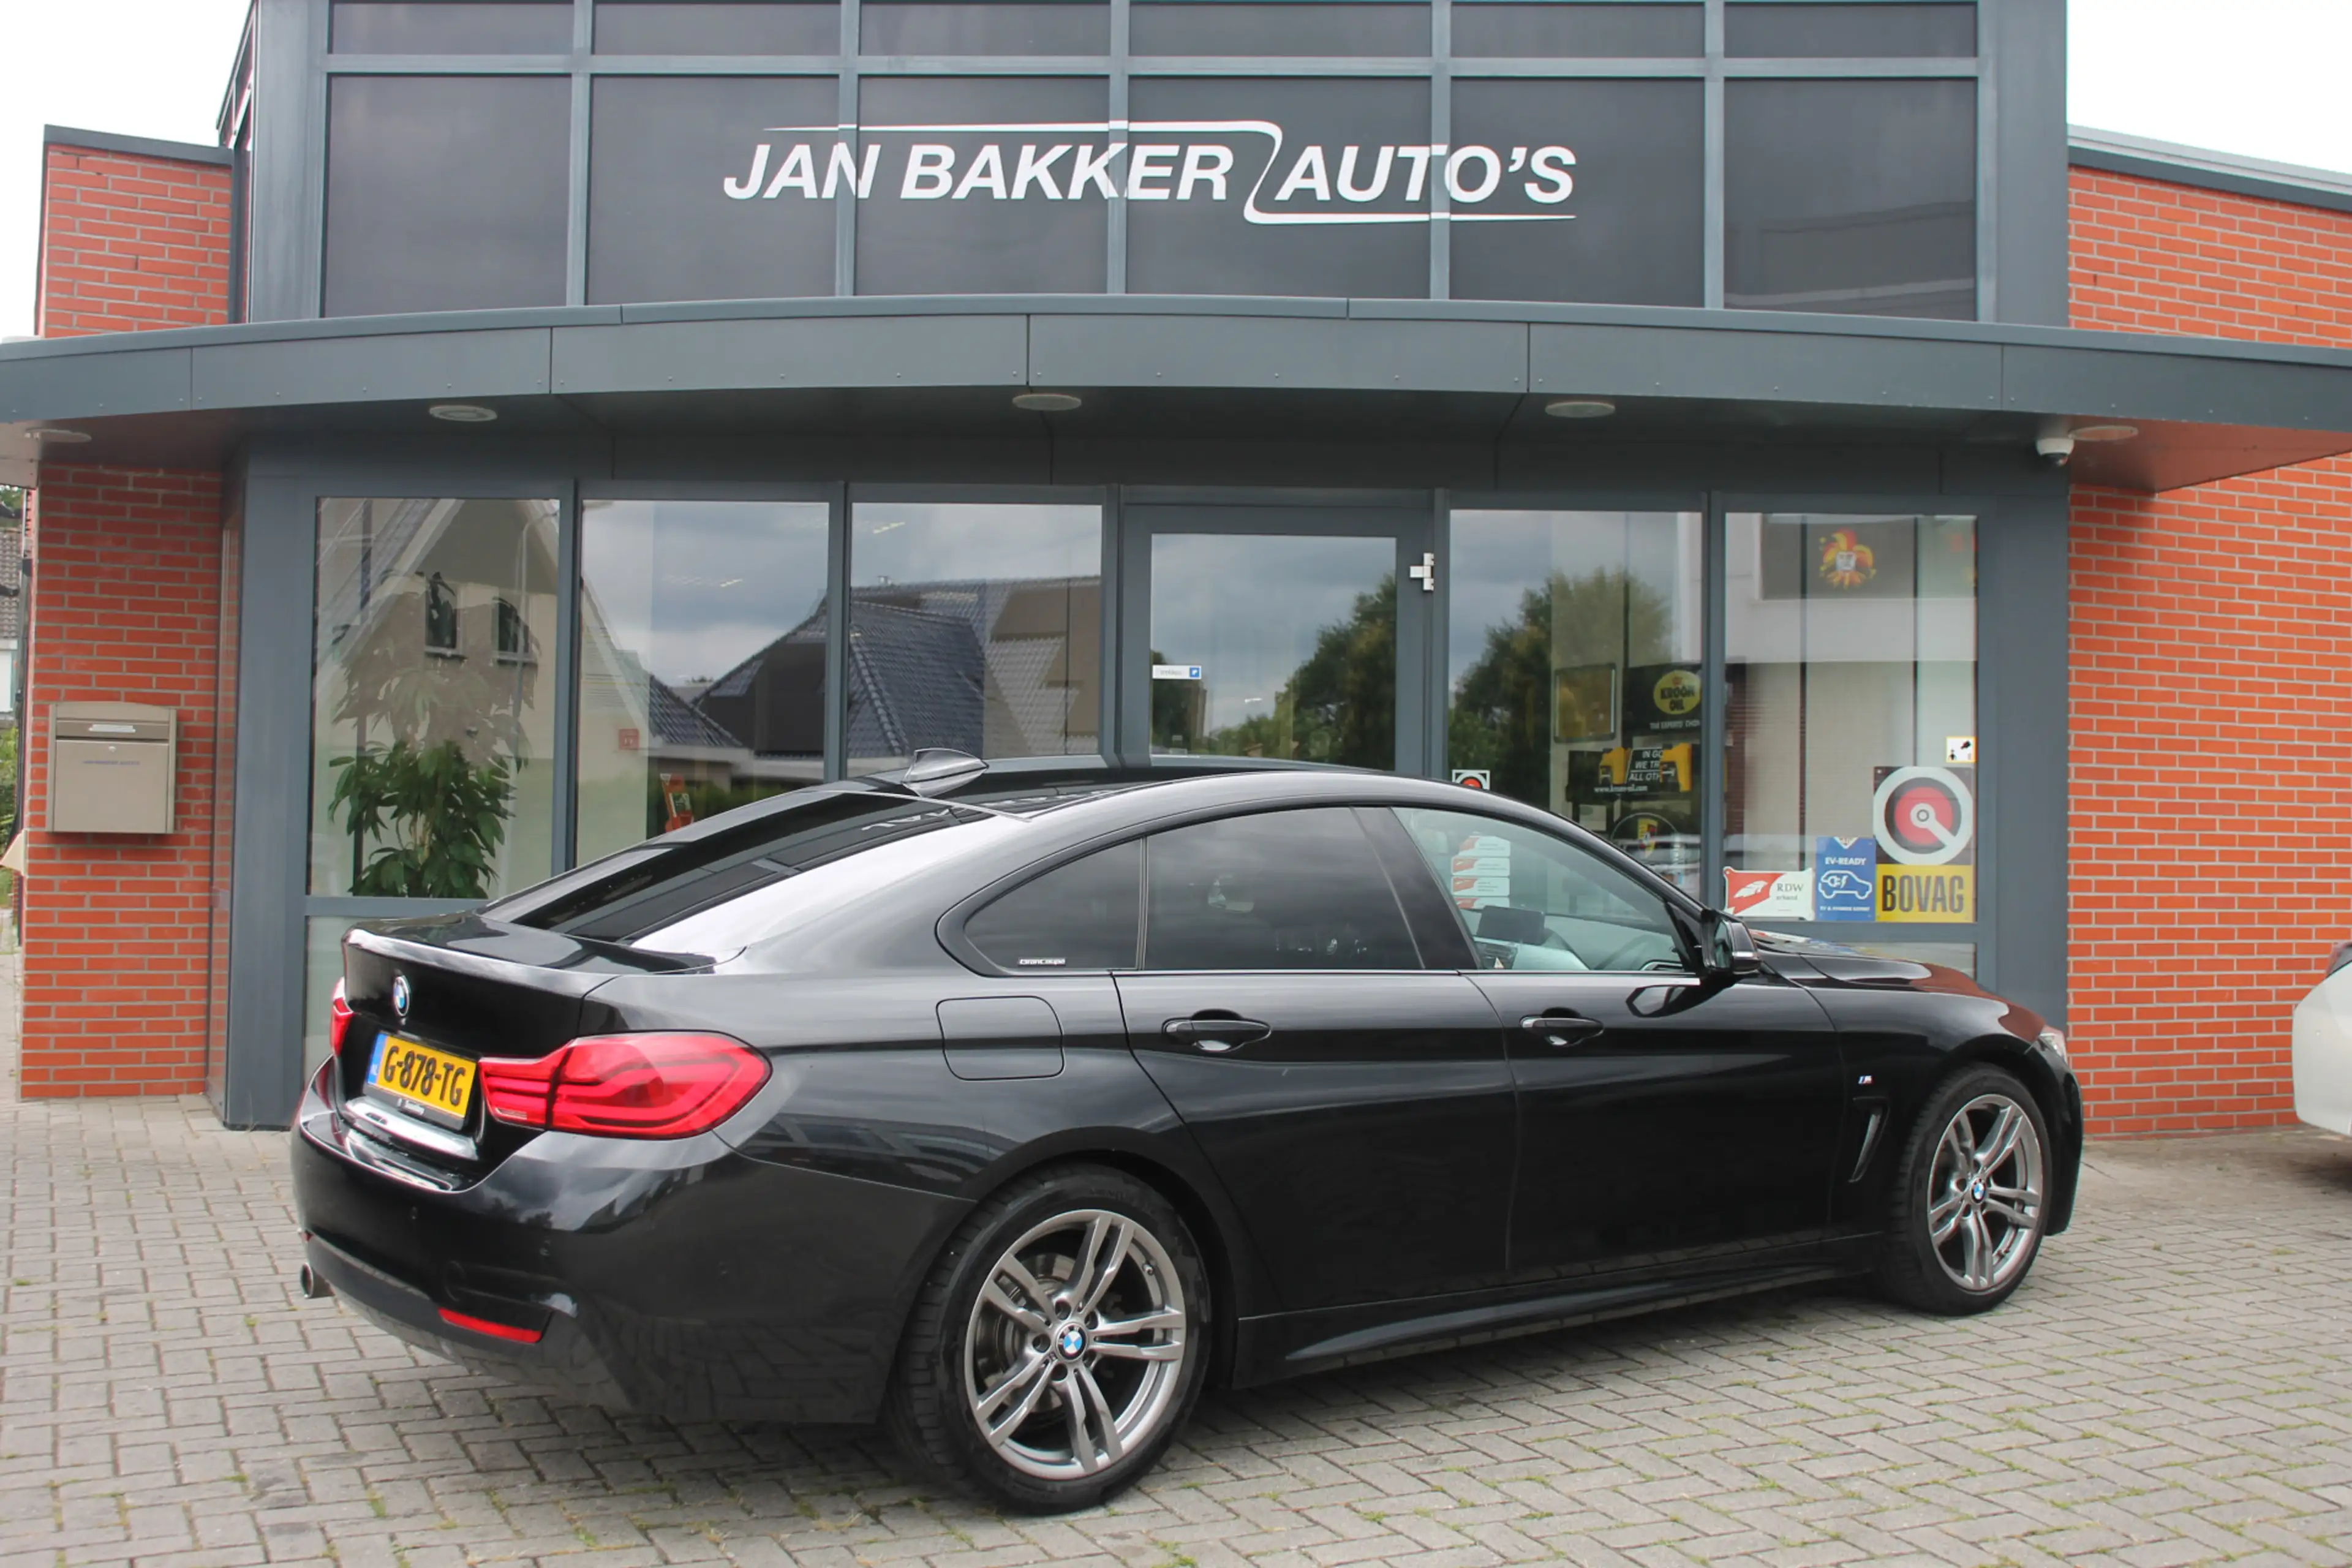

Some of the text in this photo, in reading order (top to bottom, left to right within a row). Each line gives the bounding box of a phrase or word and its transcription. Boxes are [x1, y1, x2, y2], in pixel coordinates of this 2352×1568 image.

[723, 143, 1578, 204] JAN BAKKER AUTO'S
[1825, 857, 1866, 865] EV-READY
[1777, 883, 1804, 892] RDW
[1882, 875, 1964, 913] BOVAG
[383, 1046, 466, 1106] G-878-TG
